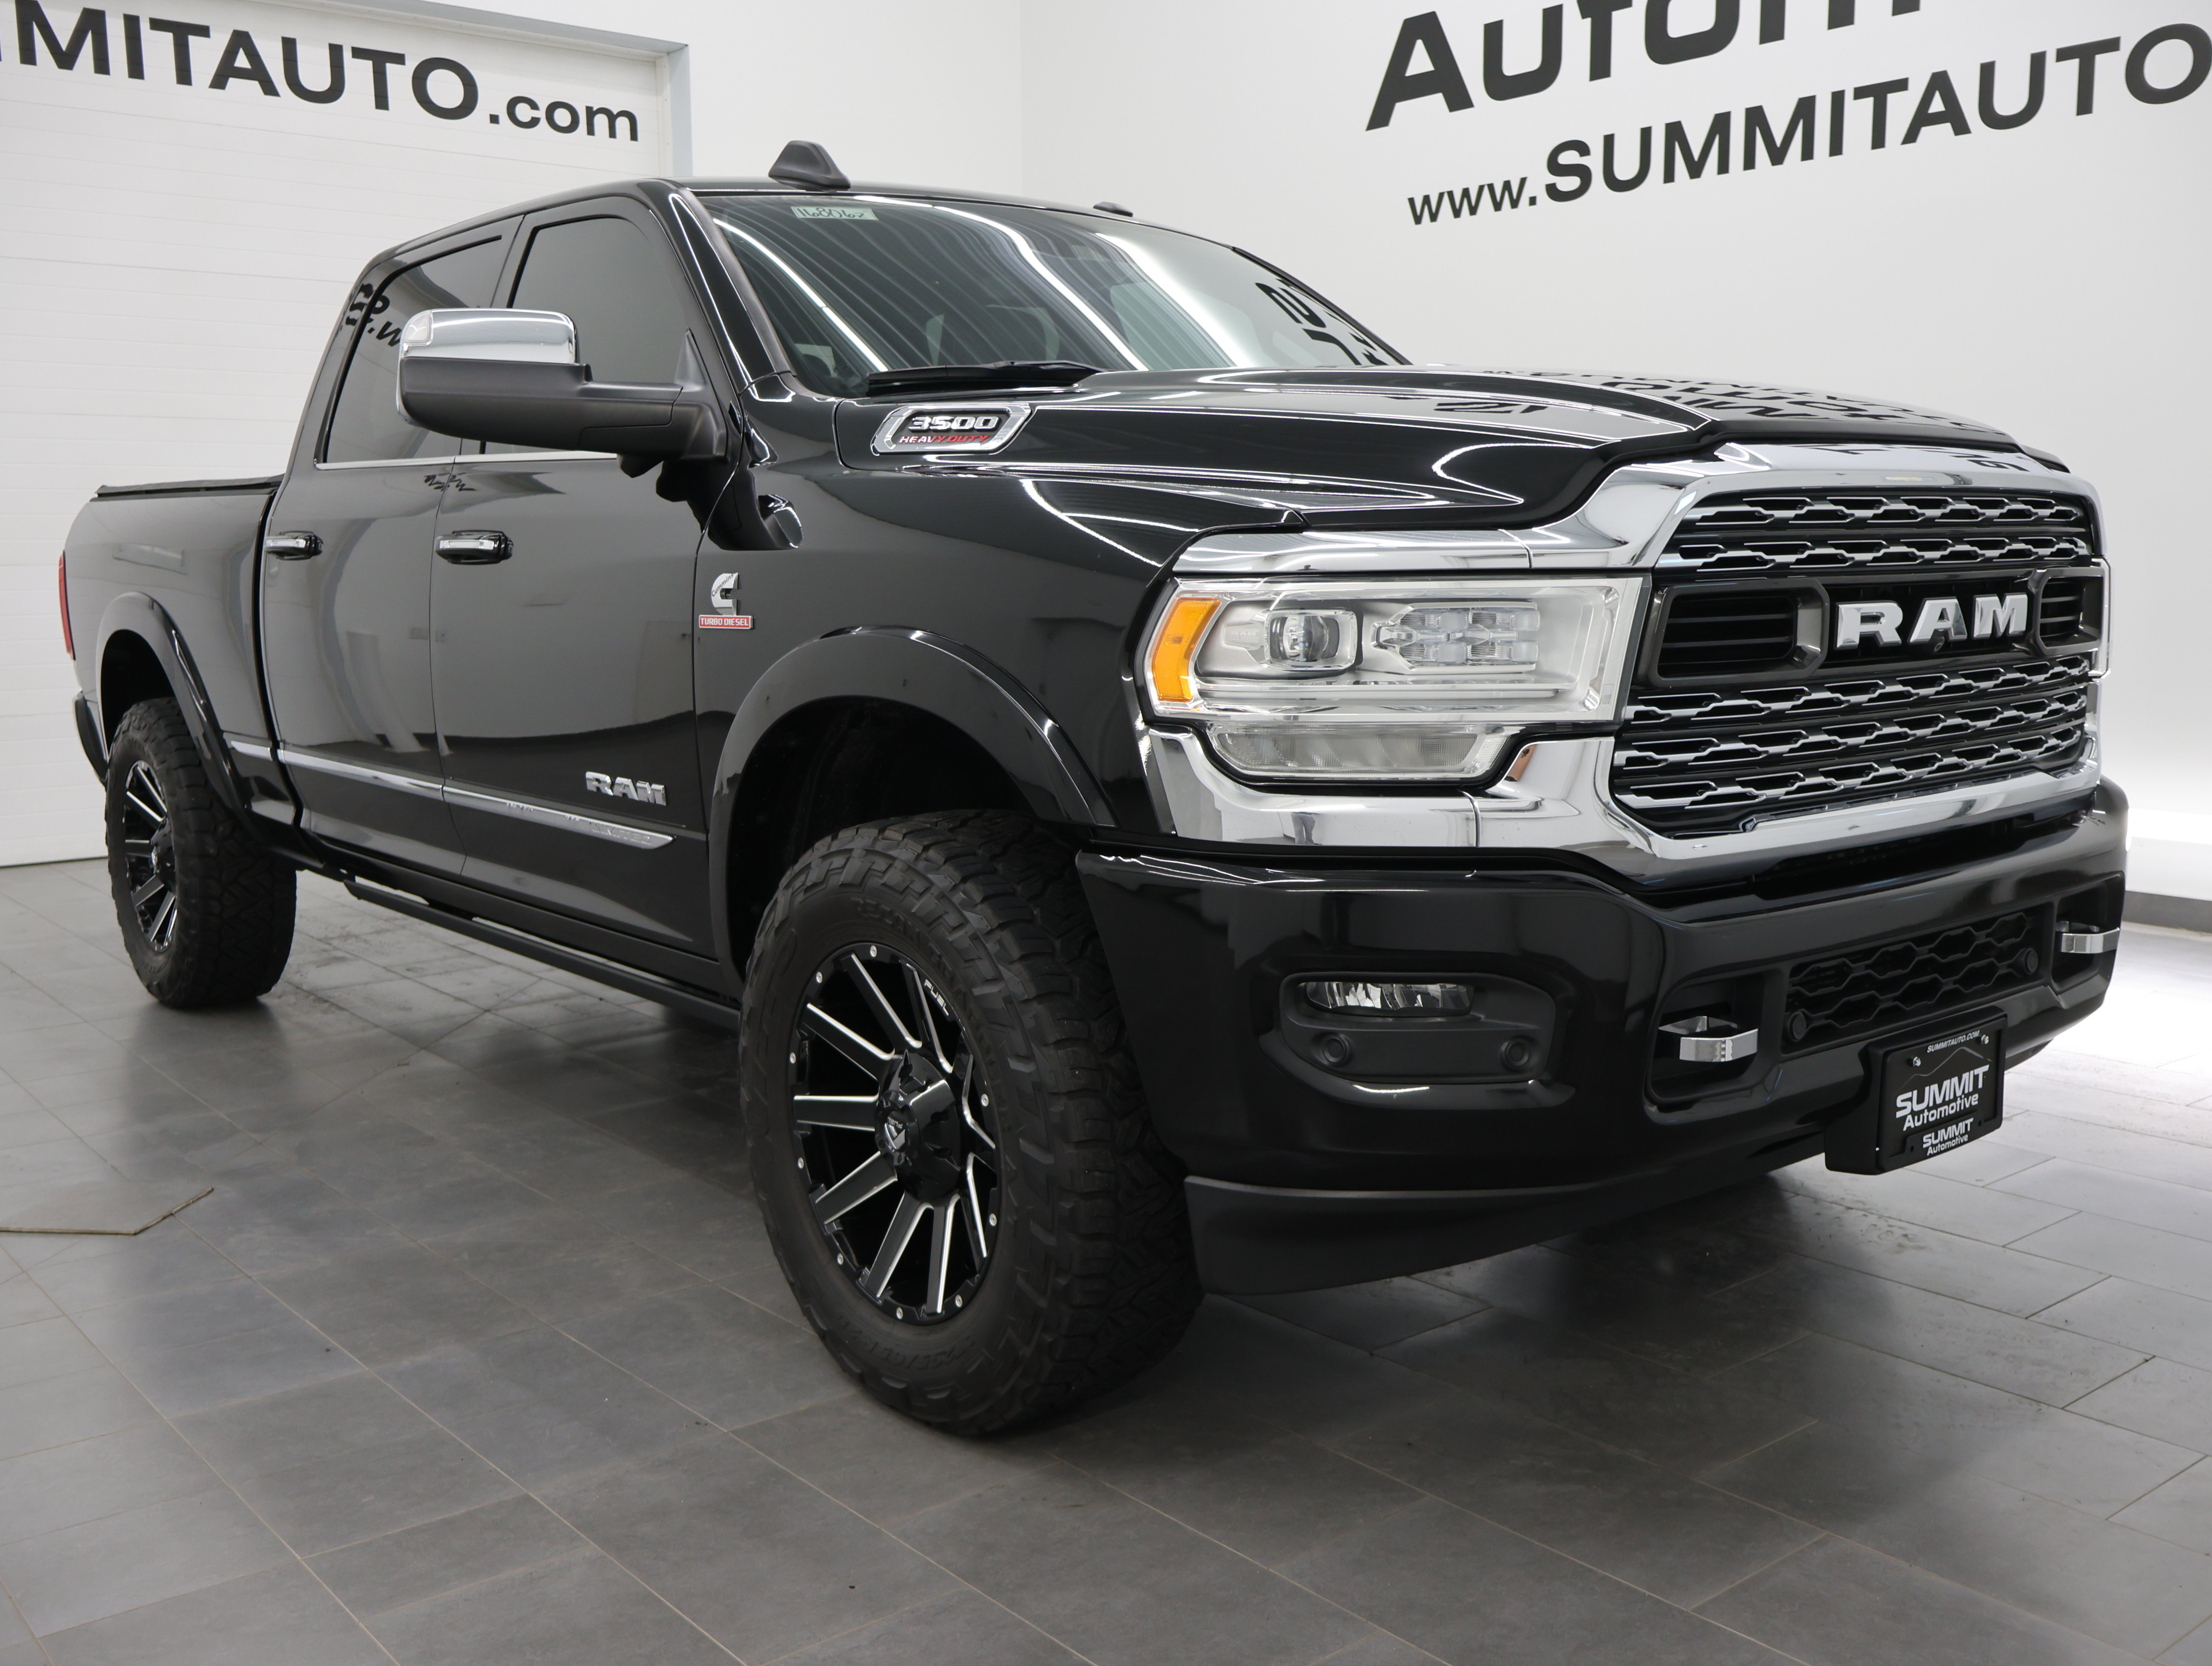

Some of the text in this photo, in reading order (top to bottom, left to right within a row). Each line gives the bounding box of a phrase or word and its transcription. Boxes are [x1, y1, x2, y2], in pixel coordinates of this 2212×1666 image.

[0, 0, 638, 142] MITAUTO.com
[908, 416, 999, 431] 3500
[899, 435, 990, 443] HEAVY DUTY
[712, 573, 734, 597] Cummins
[700, 617, 750, 626] TURBO DIESEL
[1836, 593, 2028, 649] RAM
[585, 771, 666, 806] RAM
[924, 979, 950, 1016] FUEL
[1927, 1030, 1980, 1053] SUMMITAUTO.COM
[1896, 1064, 1989, 1118] SUMMIT
[1903, 1093, 1979, 1131] Automotive
[1923, 1118, 1974, 1148] SUMMIT
[1927, 1134, 1968, 1156] Automotive
